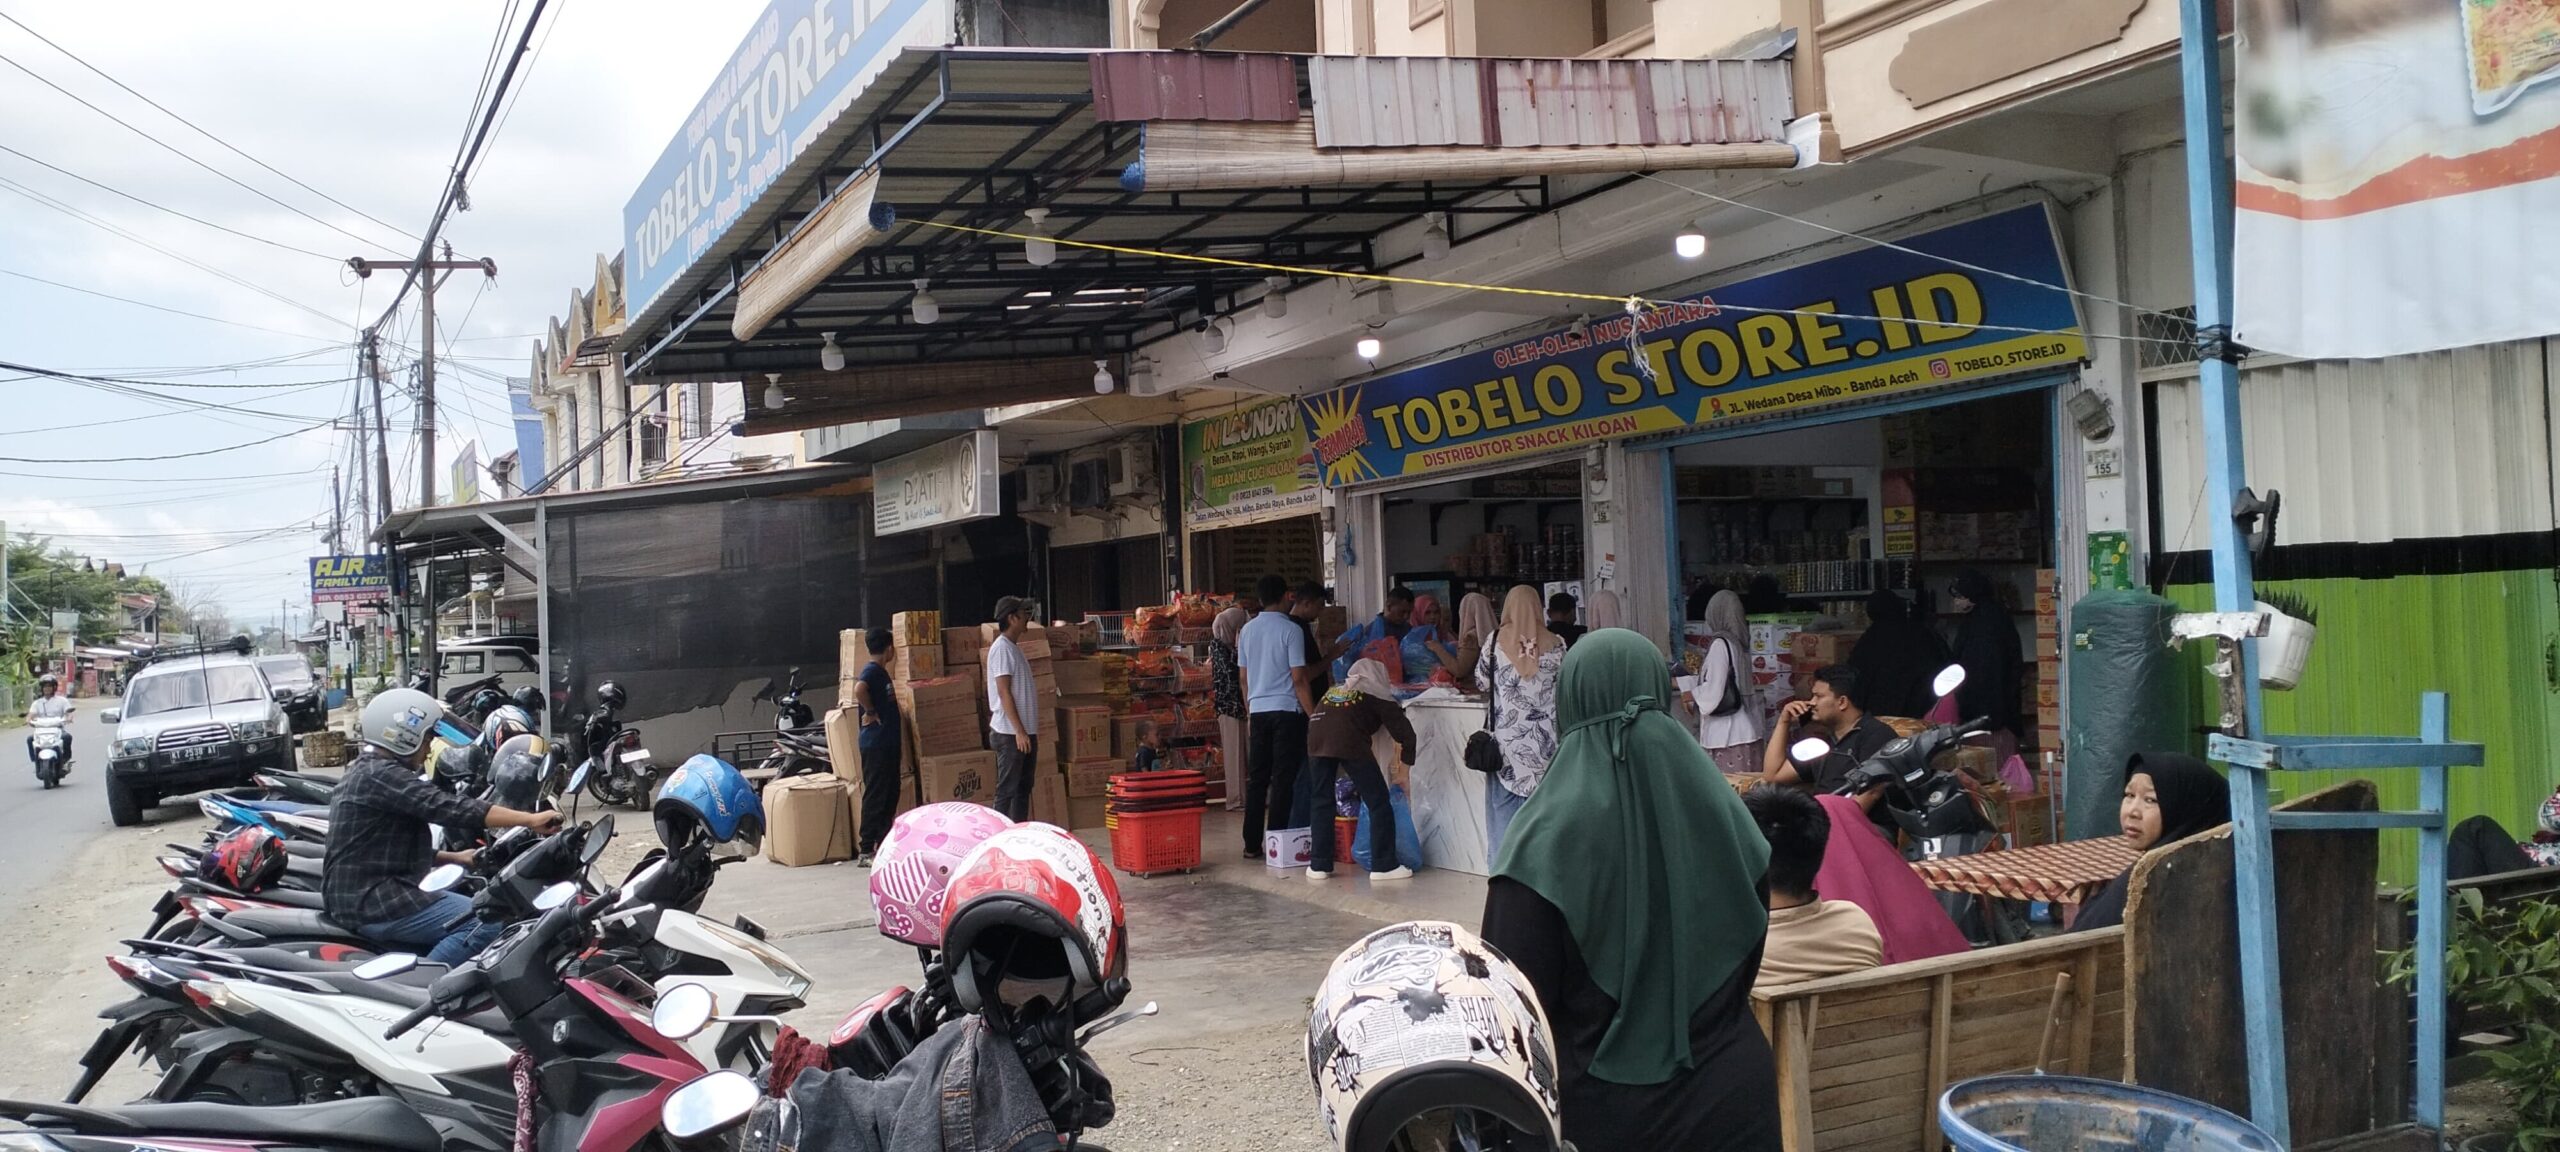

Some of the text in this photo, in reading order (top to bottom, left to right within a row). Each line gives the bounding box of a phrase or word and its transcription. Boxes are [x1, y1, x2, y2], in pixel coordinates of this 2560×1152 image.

[635, 137, 717, 280] TOBELO
[1494, 296, 1720, 368] OLEH-OLEH NUSANTARA
[1373, 273, 1985, 449] TOBELO STORE.ID
[1955, 343, 2066, 373] TOBELO_STORE.ID
[1728, 403, 1744, 414] JL.
[1744, 394, 1786, 411] Wedana
[1787, 390, 1813, 404] Desa
[1815, 385, 1842, 399] Mibo
[1850, 376, 1887, 393] Banda
[1890, 370, 1919, 386] Aceh
[1247, 443, 1268, 458] Wangi,
[1269, 437, 1291, 454] Syariah
[1423, 416, 1638, 467] DISTRIBUTOR SNACK KILOAN
[2094, 463, 2111, 475] 155
[314, 557, 365, 577] AJR
[315, 577, 359, 588] FAMILY
